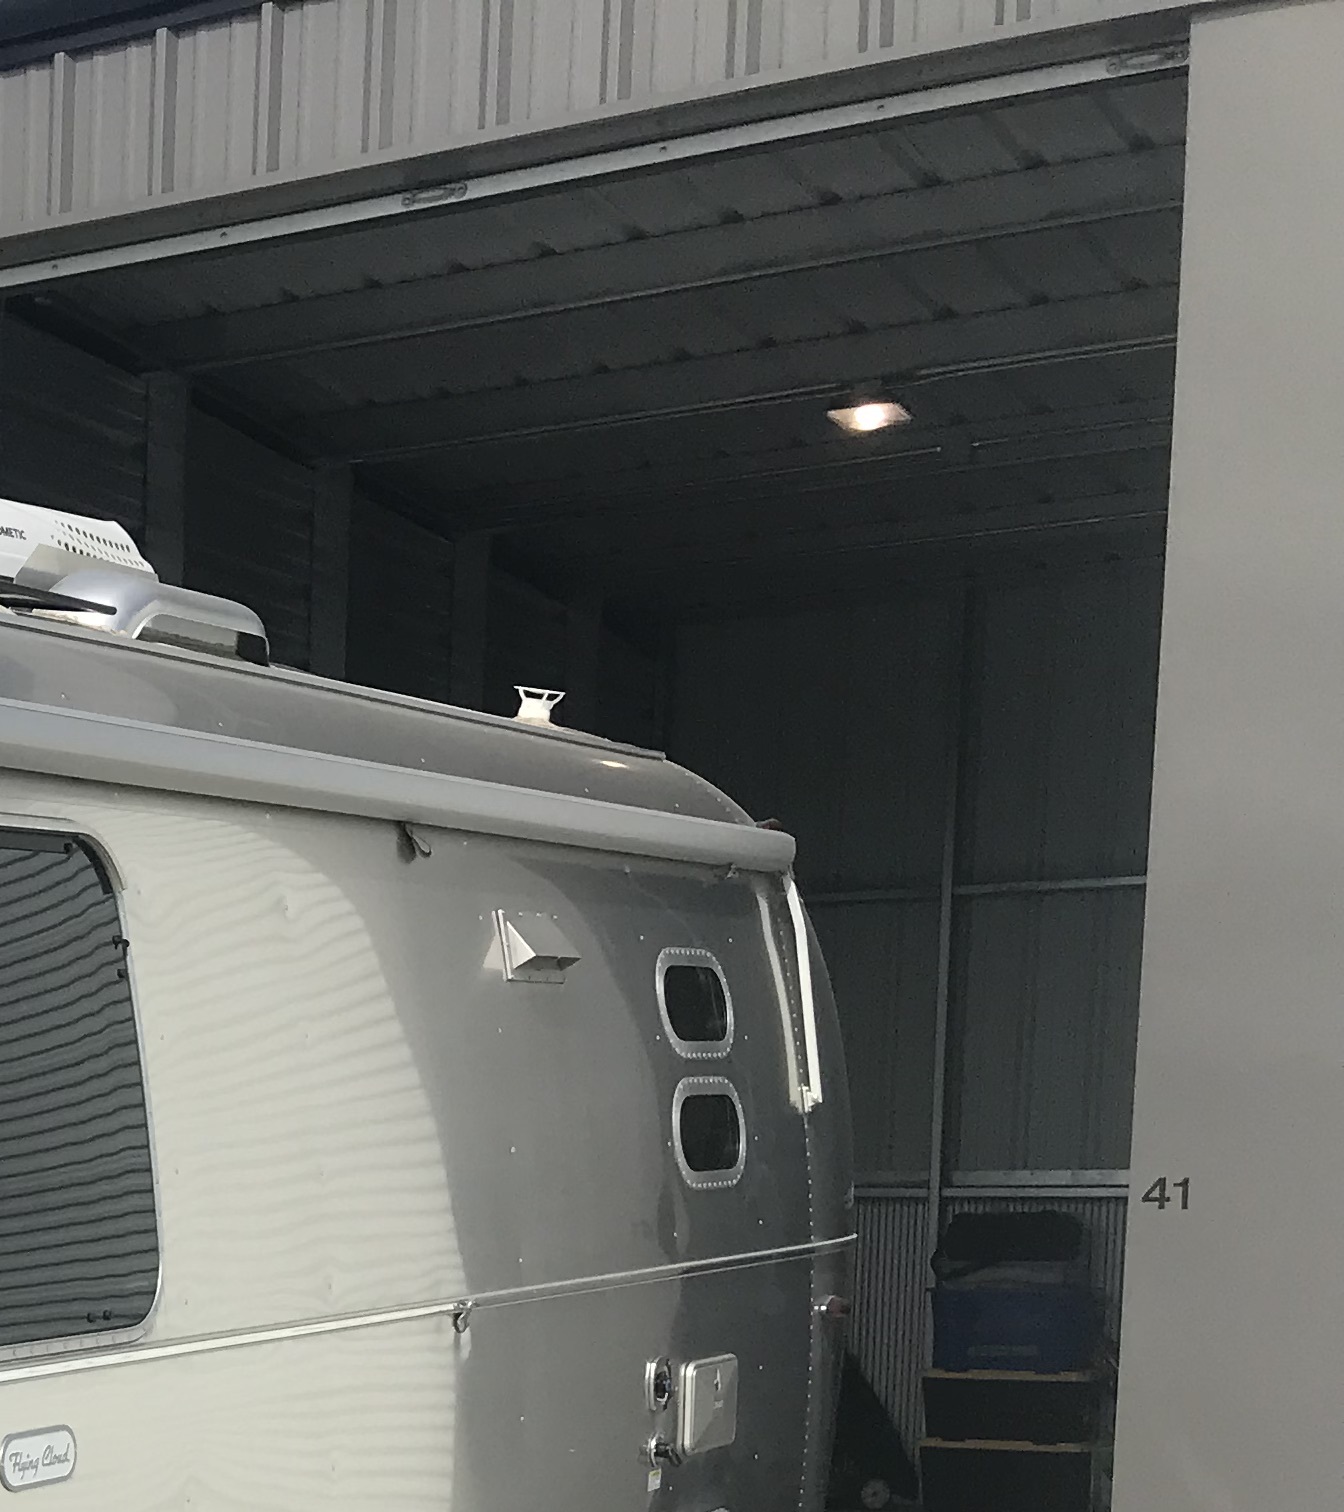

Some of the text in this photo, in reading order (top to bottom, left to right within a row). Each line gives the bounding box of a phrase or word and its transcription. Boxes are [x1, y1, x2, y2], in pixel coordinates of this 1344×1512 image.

[1141, 1176, 1190, 1210] 41
[9, 1444, 71, 1480] Flying Cloud
